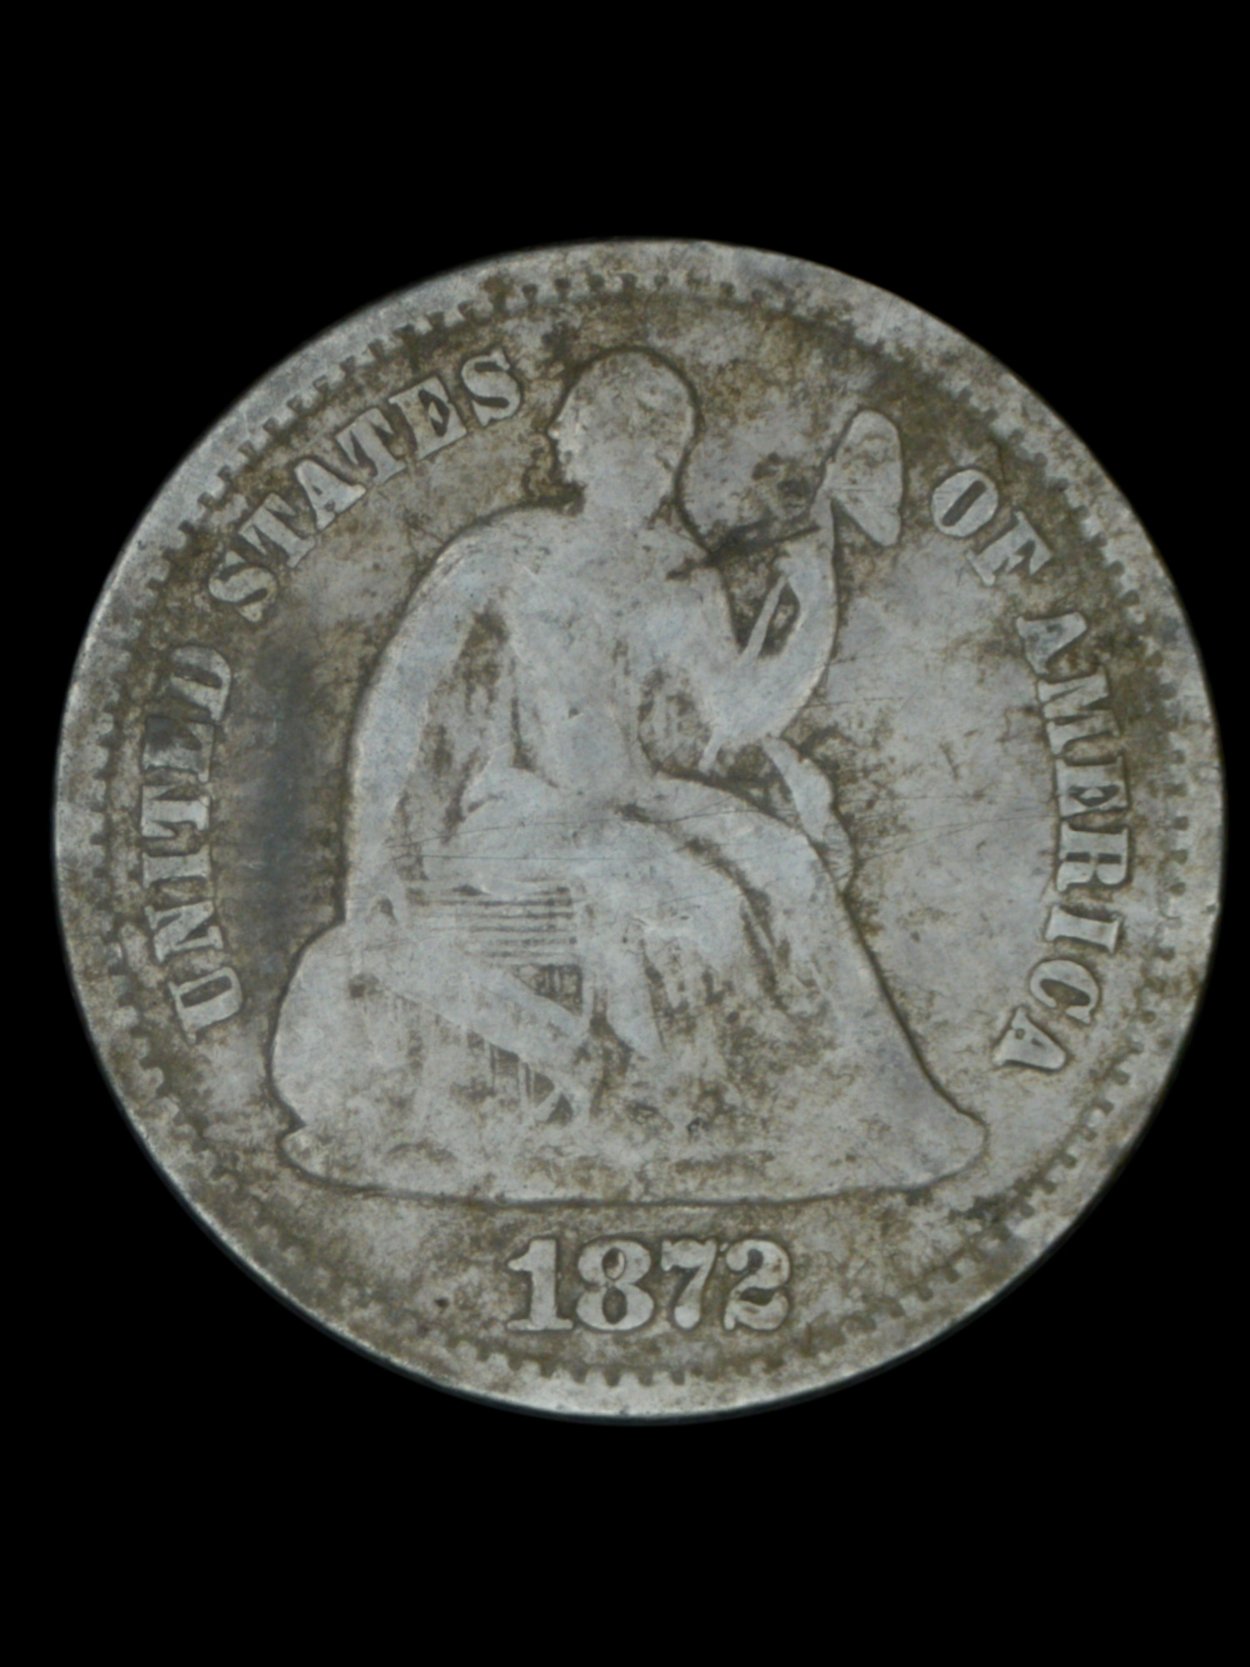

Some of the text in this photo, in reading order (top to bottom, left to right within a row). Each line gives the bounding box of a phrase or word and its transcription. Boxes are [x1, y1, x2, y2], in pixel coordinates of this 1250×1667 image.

[142, 349, 1132, 1073] UNITED STATES OF AMERICA
[503, 1237, 793, 1333] 1872
